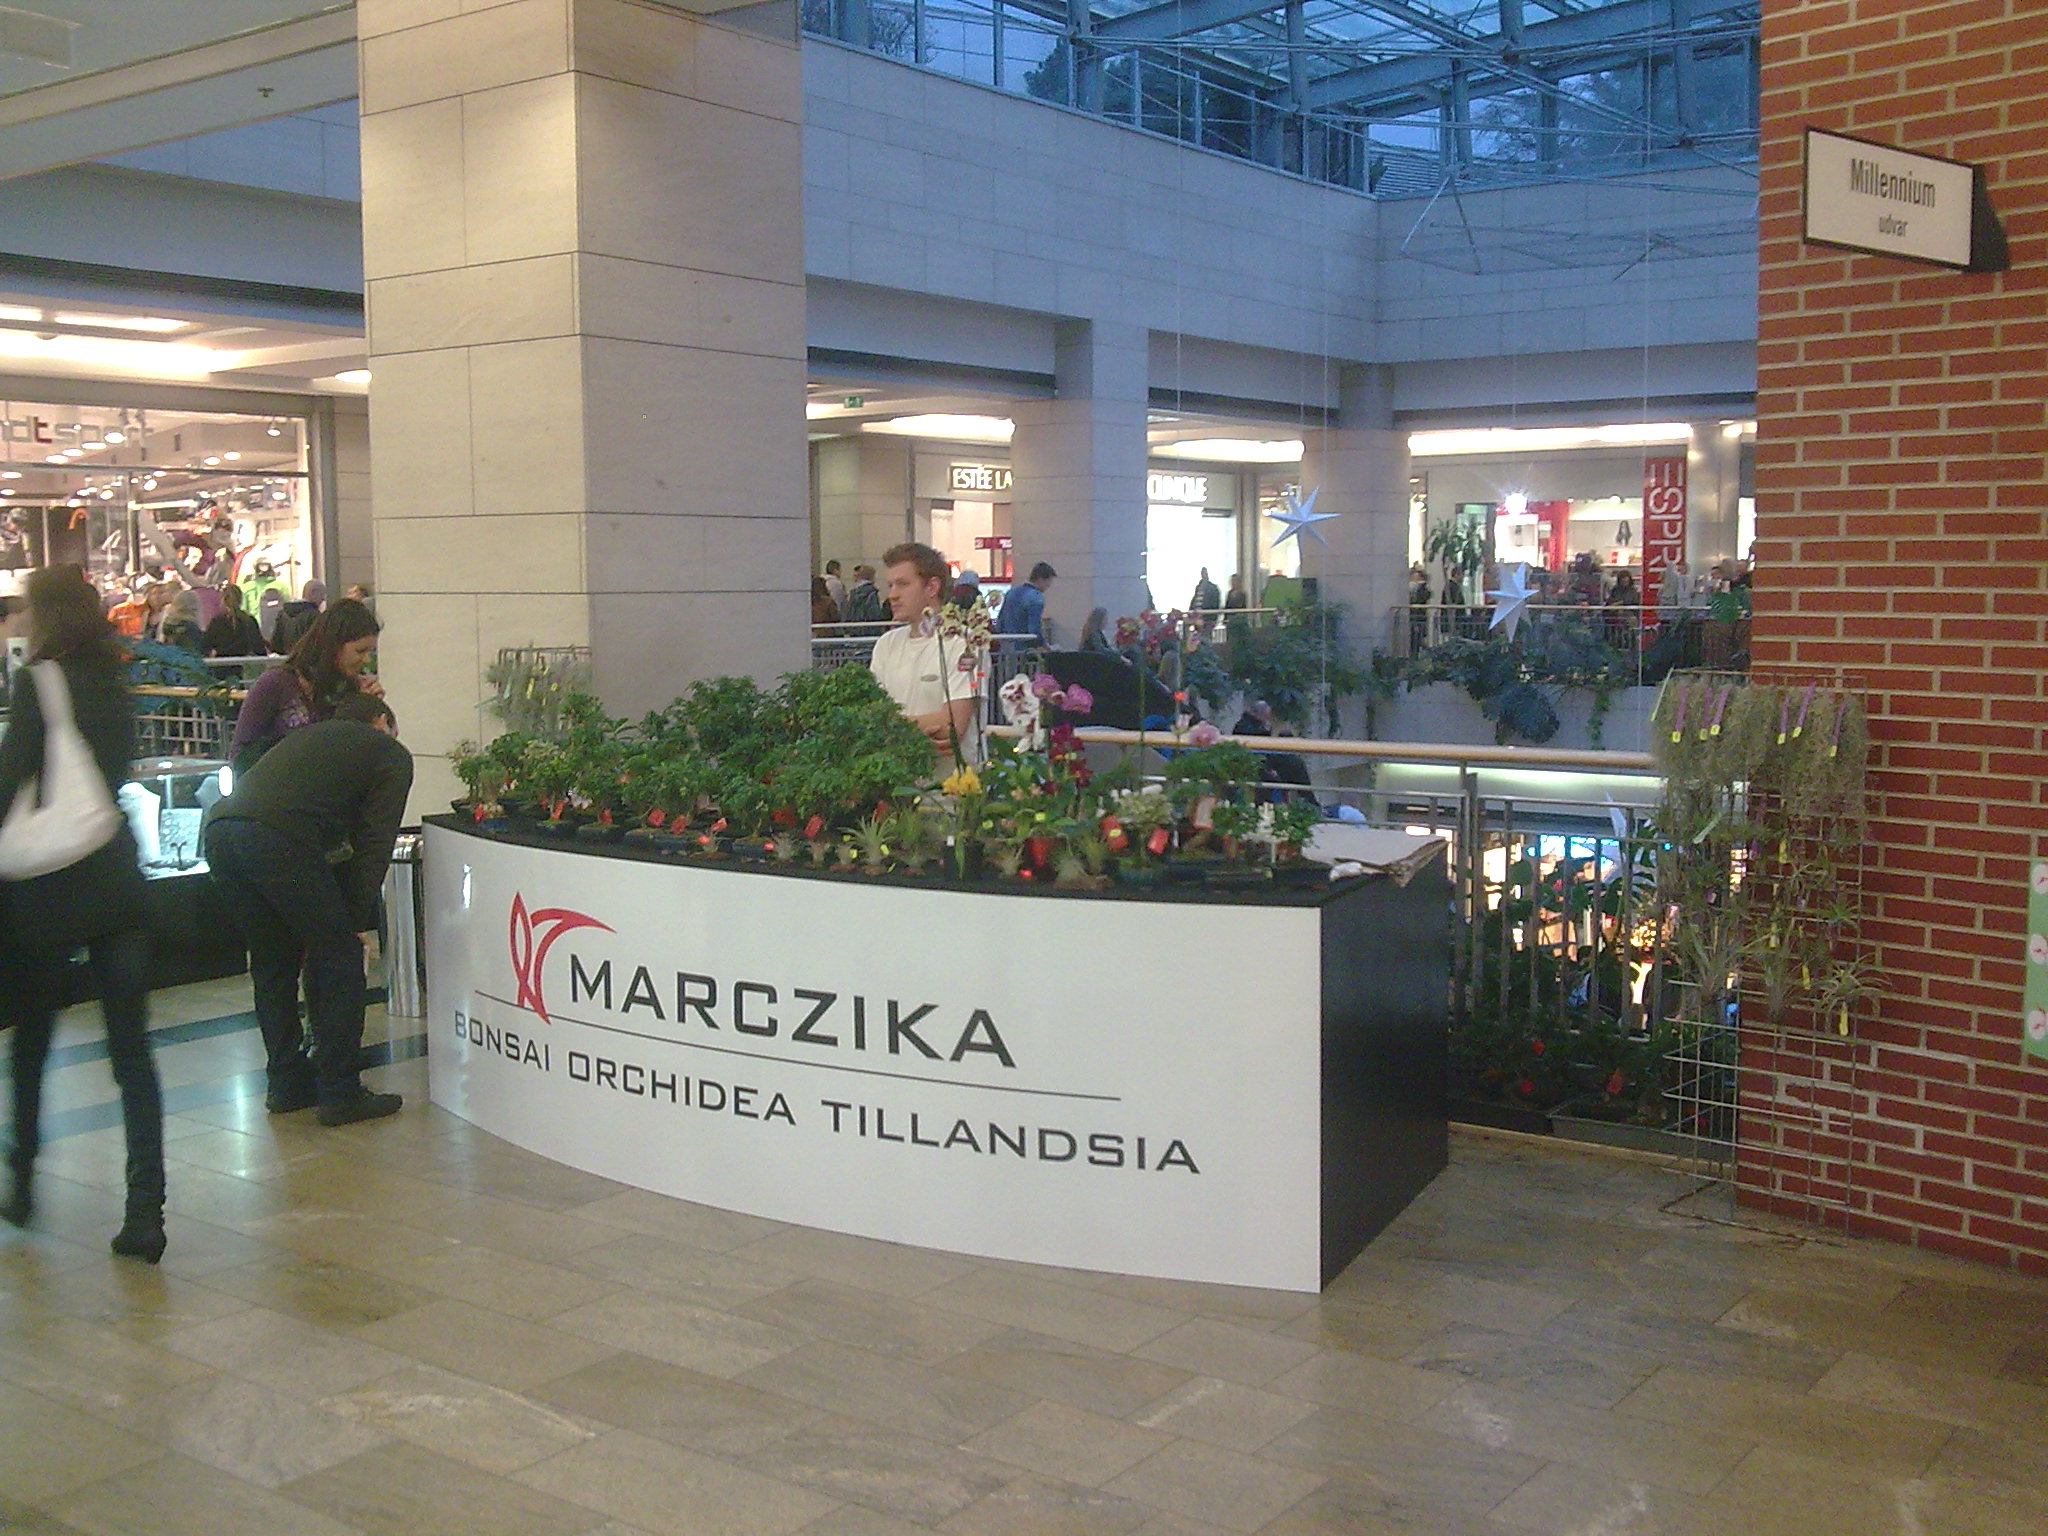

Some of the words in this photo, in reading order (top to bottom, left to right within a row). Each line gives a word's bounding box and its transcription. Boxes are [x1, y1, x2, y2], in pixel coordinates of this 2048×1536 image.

[1851, 158, 1936, 208] Millennium
[1878, 213, 1908, 237] udvar
[569, 952, 1018, 1070] MARCZIKA
[453, 1009, 551, 1072] BONSAI
[567, 1050, 797, 1127] ORCHIDEA
[820, 1098, 1201, 1175] TILLANDSIA
